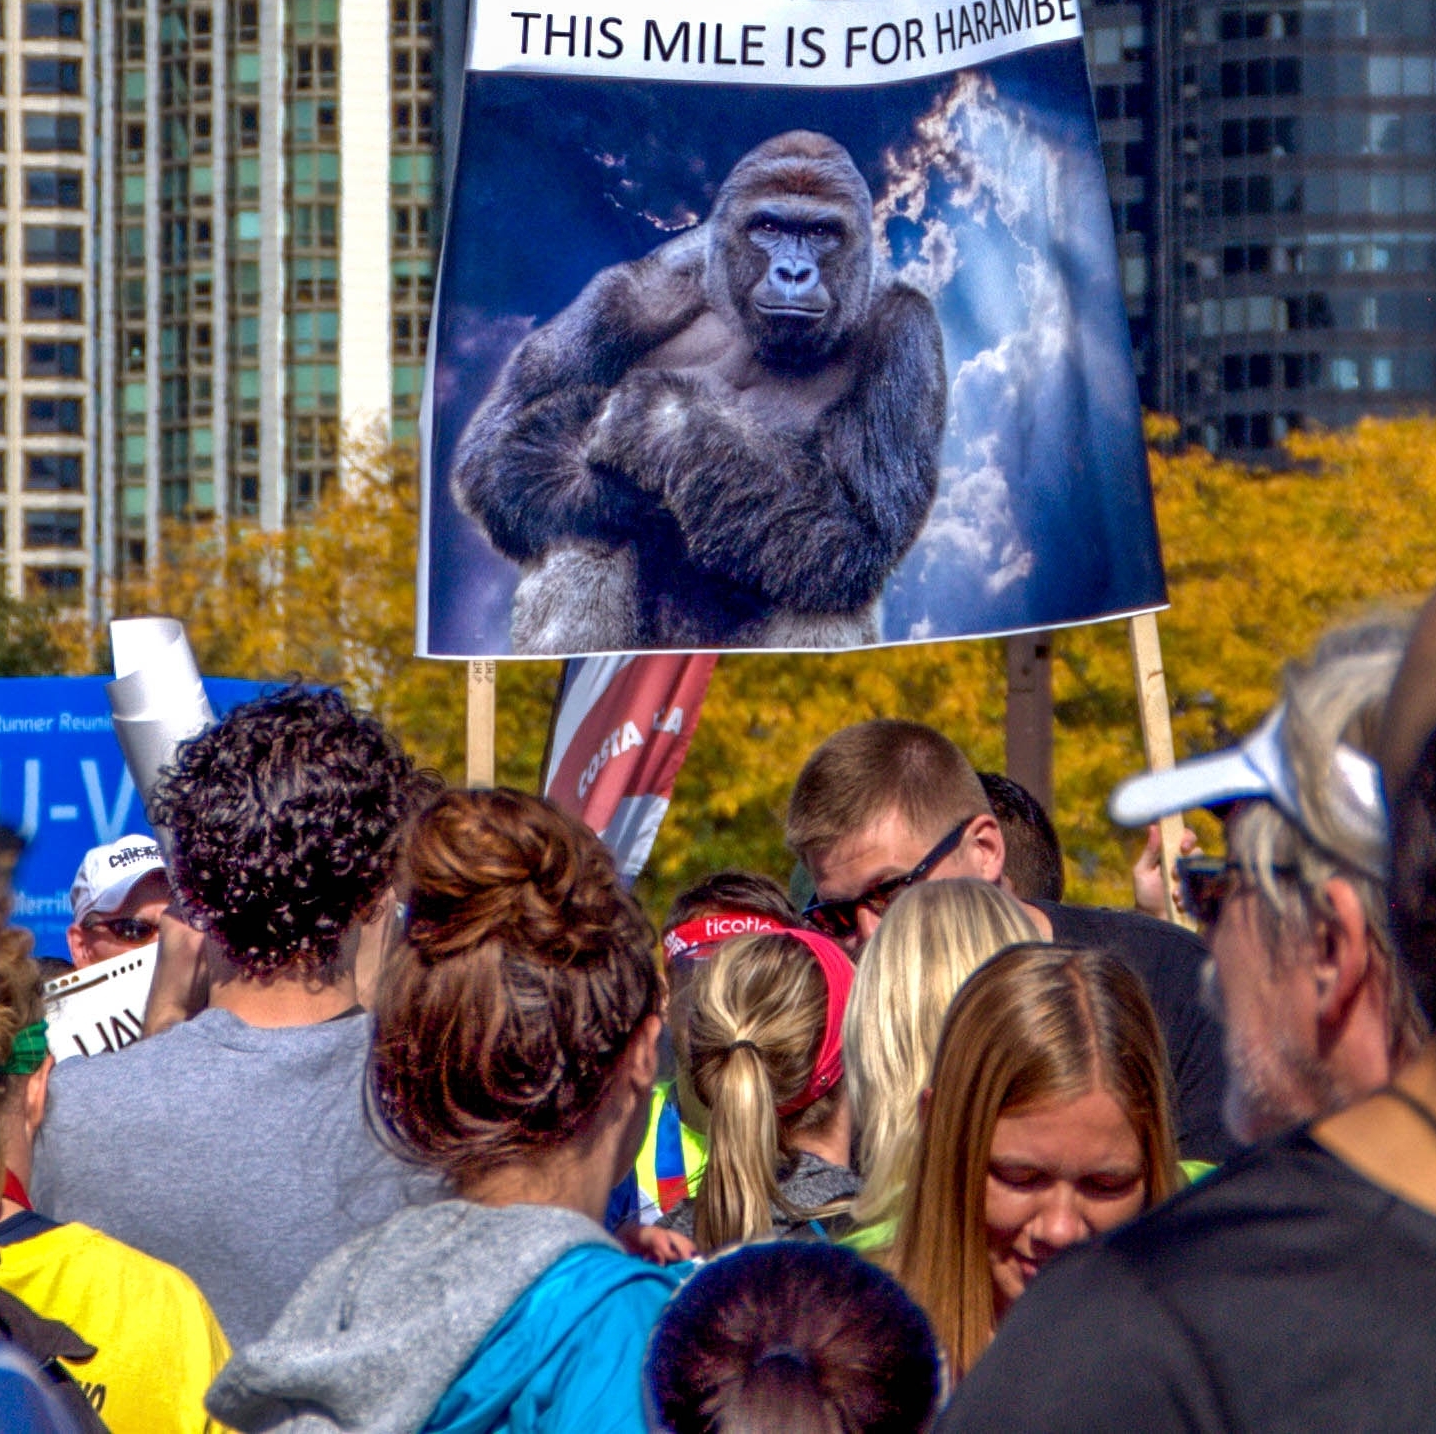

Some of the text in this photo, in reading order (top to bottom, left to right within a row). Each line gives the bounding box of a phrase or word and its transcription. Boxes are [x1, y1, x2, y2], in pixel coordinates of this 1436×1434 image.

[510, 10, 625, 60] THIS
[643, 19, 767, 67] MILE
[785, 26, 827, 69] IS
[845, 18, 927, 69] FOR
[59, 712, 115, 733] Reuni
[577, 720, 644, 799] COSTA
